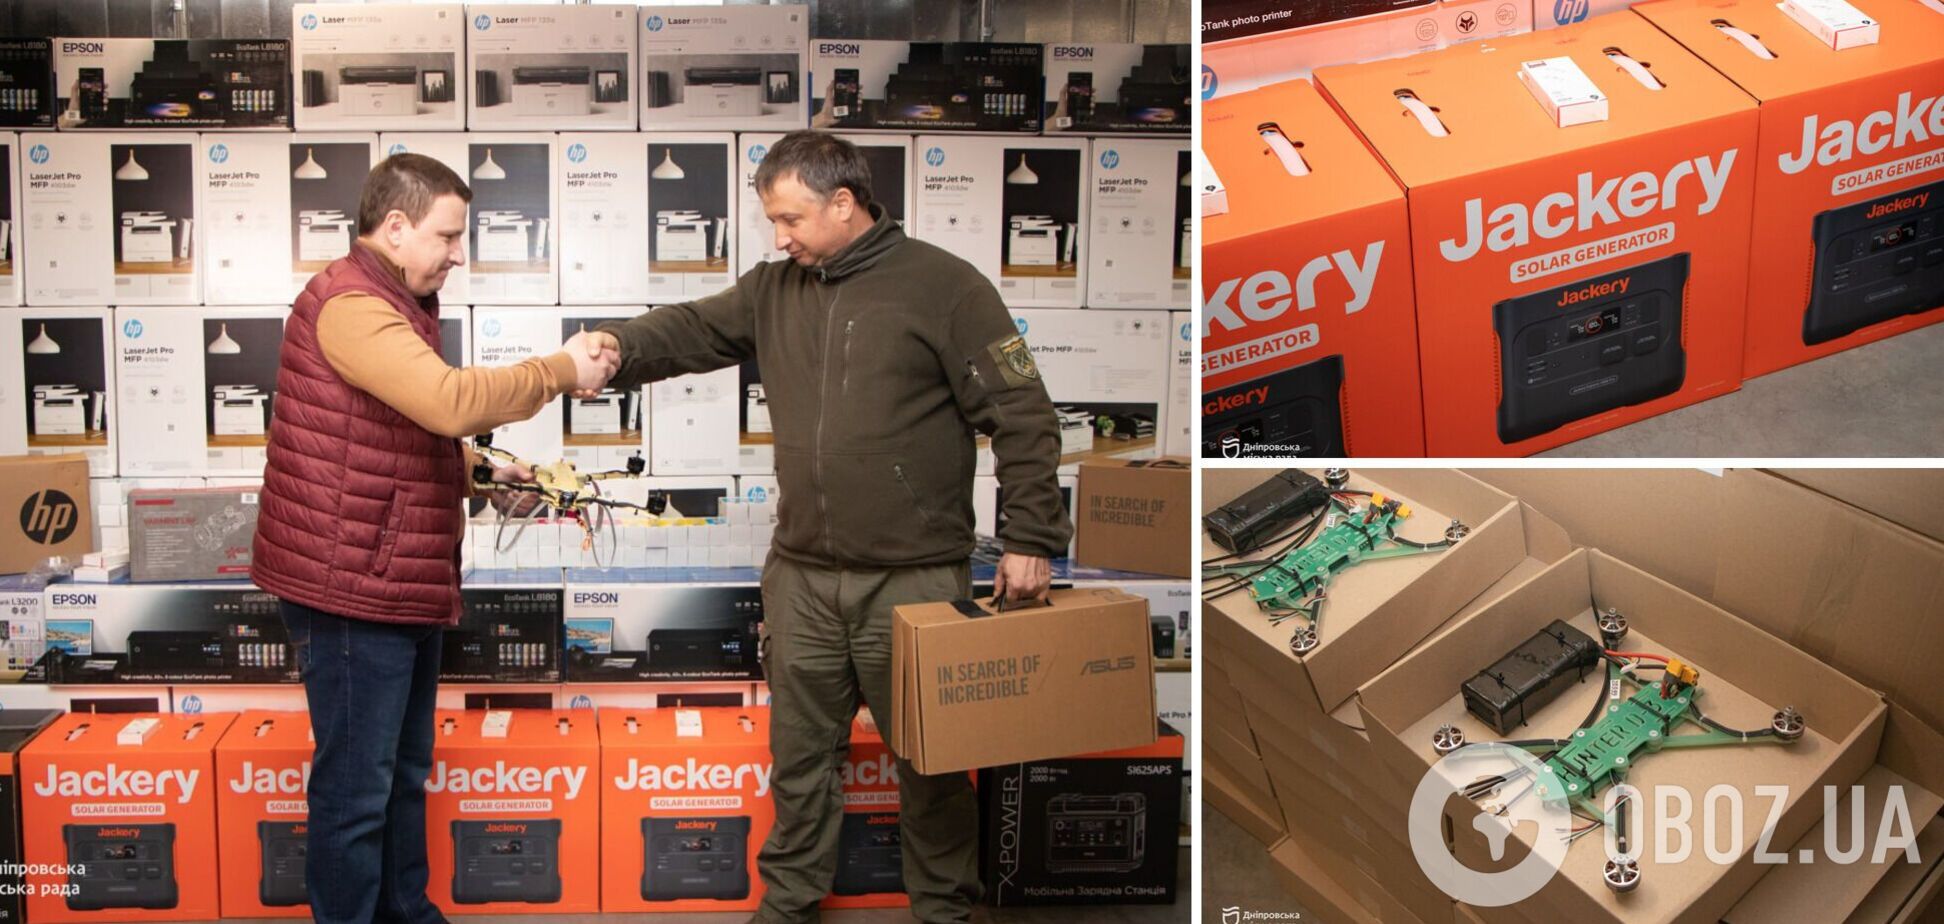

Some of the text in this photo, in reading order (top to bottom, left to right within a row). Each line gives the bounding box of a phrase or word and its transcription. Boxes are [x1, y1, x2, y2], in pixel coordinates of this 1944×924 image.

[301, 14, 318, 31] hp
[322, 16, 345, 24] Laser
[474, 14, 491, 31] hp
[496, 16, 518, 24] Laser
[646, 15, 663, 32] hp
[668, 17, 690, 25] Laser
[1232, 14, 1260, 28] photo
[1262, 9, 1293, 22] printer
[62, 43, 104, 53] EPSON
[819, 44, 860, 54] EPSON
[1054, 47, 1093, 57] EPSON
[30, 144, 49, 164] hp
[208, 144, 229, 164] hp
[567, 143, 587, 163] hp
[925, 147, 945, 167] hp
[1100, 150, 1120, 169] hp
[30, 173, 81, 181] LaserJet Pro
[208, 172, 260, 180] LaserJet Pro
[567, 171, 618, 180] LaserJet Pro
[925, 175, 974, 184] LaserJet Pro
[1837, 165, 1884, 191] SOLAR
[208, 180, 227, 189] MFP
[567, 180, 585, 188] MFP
[925, 183, 942, 192] MFP
[1099, 177, 1148, 187] LaserJet Pro
[1099, 186, 1116, 194] MFP
[1439, 148, 1738, 262] Jackery
[1866, 191, 1930, 220] Jackery
[1516, 227, 1669, 278] SOLAR GENERATOR
[1556, 276, 1631, 307] Jackery
[123, 319, 143, 339] hp
[124, 347, 174, 355] LaserJet Pro
[482, 346, 515, 354] LaserJet
[124, 355, 142, 363] MFP
[1090, 494, 1167, 511] IN SEARCH OF
[24, 489, 76, 545] hp
[1090, 510, 1155, 528] INCREDIBLE
[52, 594, 97, 605] EPSON
[573, 592, 619, 604] EPSON
[937, 654, 1041, 684] IN SEARCH OF
[1080, 655, 1136, 676] ASUS
[938, 677, 1030, 706] INCREDIBLE
[1172, 711, 1186, 719] Pro
[1030, 766, 1049, 774] 2000
[424, 760, 588, 800] Jackery
[614, 757, 772, 797] Jackery
[1030, 775, 1048, 783] 2000
[34, 763, 200, 804] Jackery
[269, 802, 300, 812] SOLAR
[463, 800, 550, 811] SOLAR GENERATOR
[653, 797, 740, 808] SOLAR GENERATOR
[74, 804, 163, 815] SOLAR GENERATOR
[485, 822, 527, 834] Jackery
[675, 819, 717, 832] Jackery
[1000, 775, 1020, 888] X-POWER
[98, 827, 141, 838] Jackery
[1024, 885, 1167, 897] Мобільна Зарядна Станція
